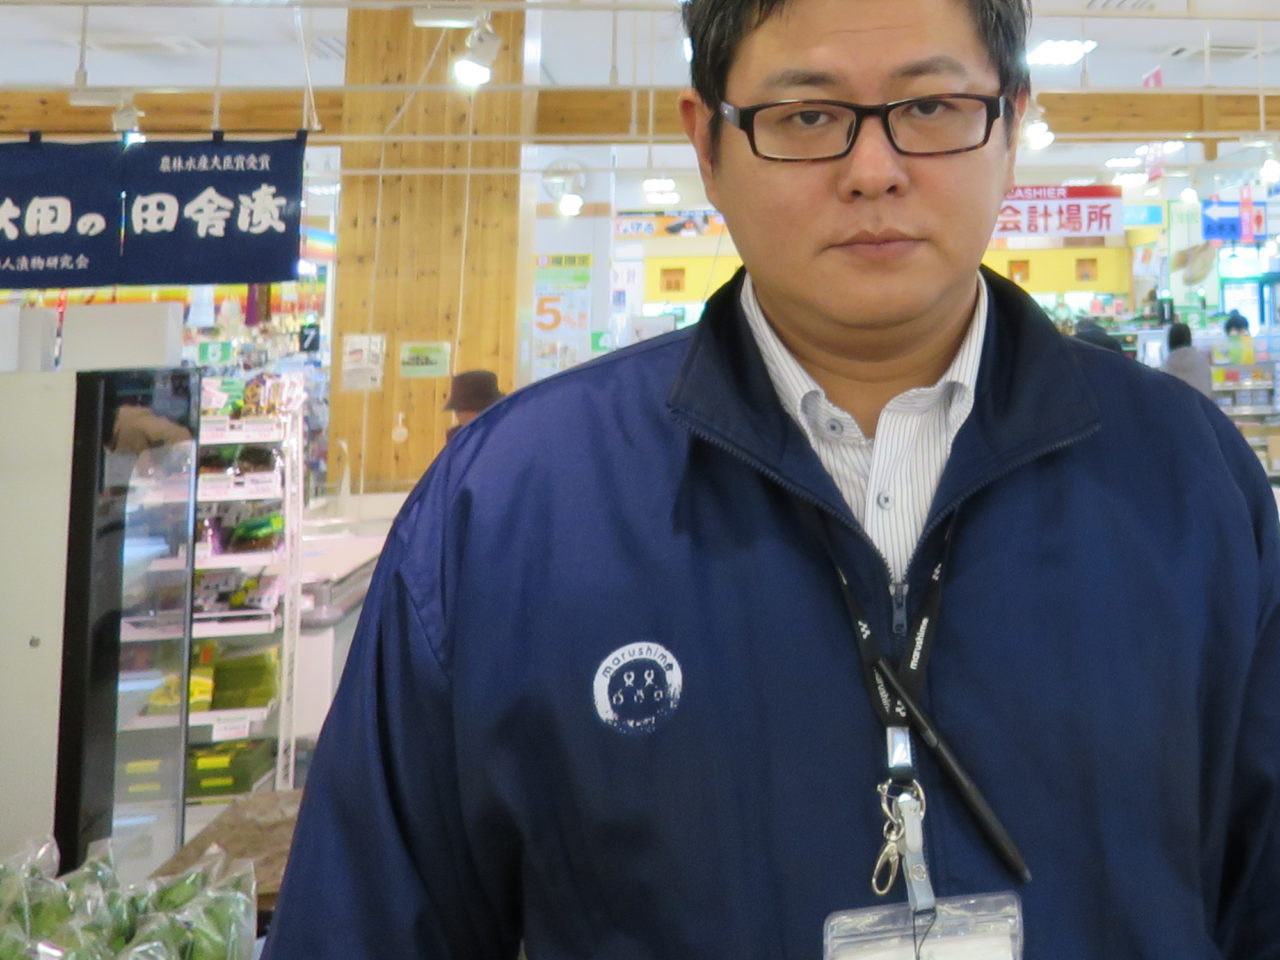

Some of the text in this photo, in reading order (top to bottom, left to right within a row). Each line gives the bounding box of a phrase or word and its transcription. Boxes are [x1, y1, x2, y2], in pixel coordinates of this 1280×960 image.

[998, 204, 1112, 233] 会計場所
[303, 327, 316, 350] 7
